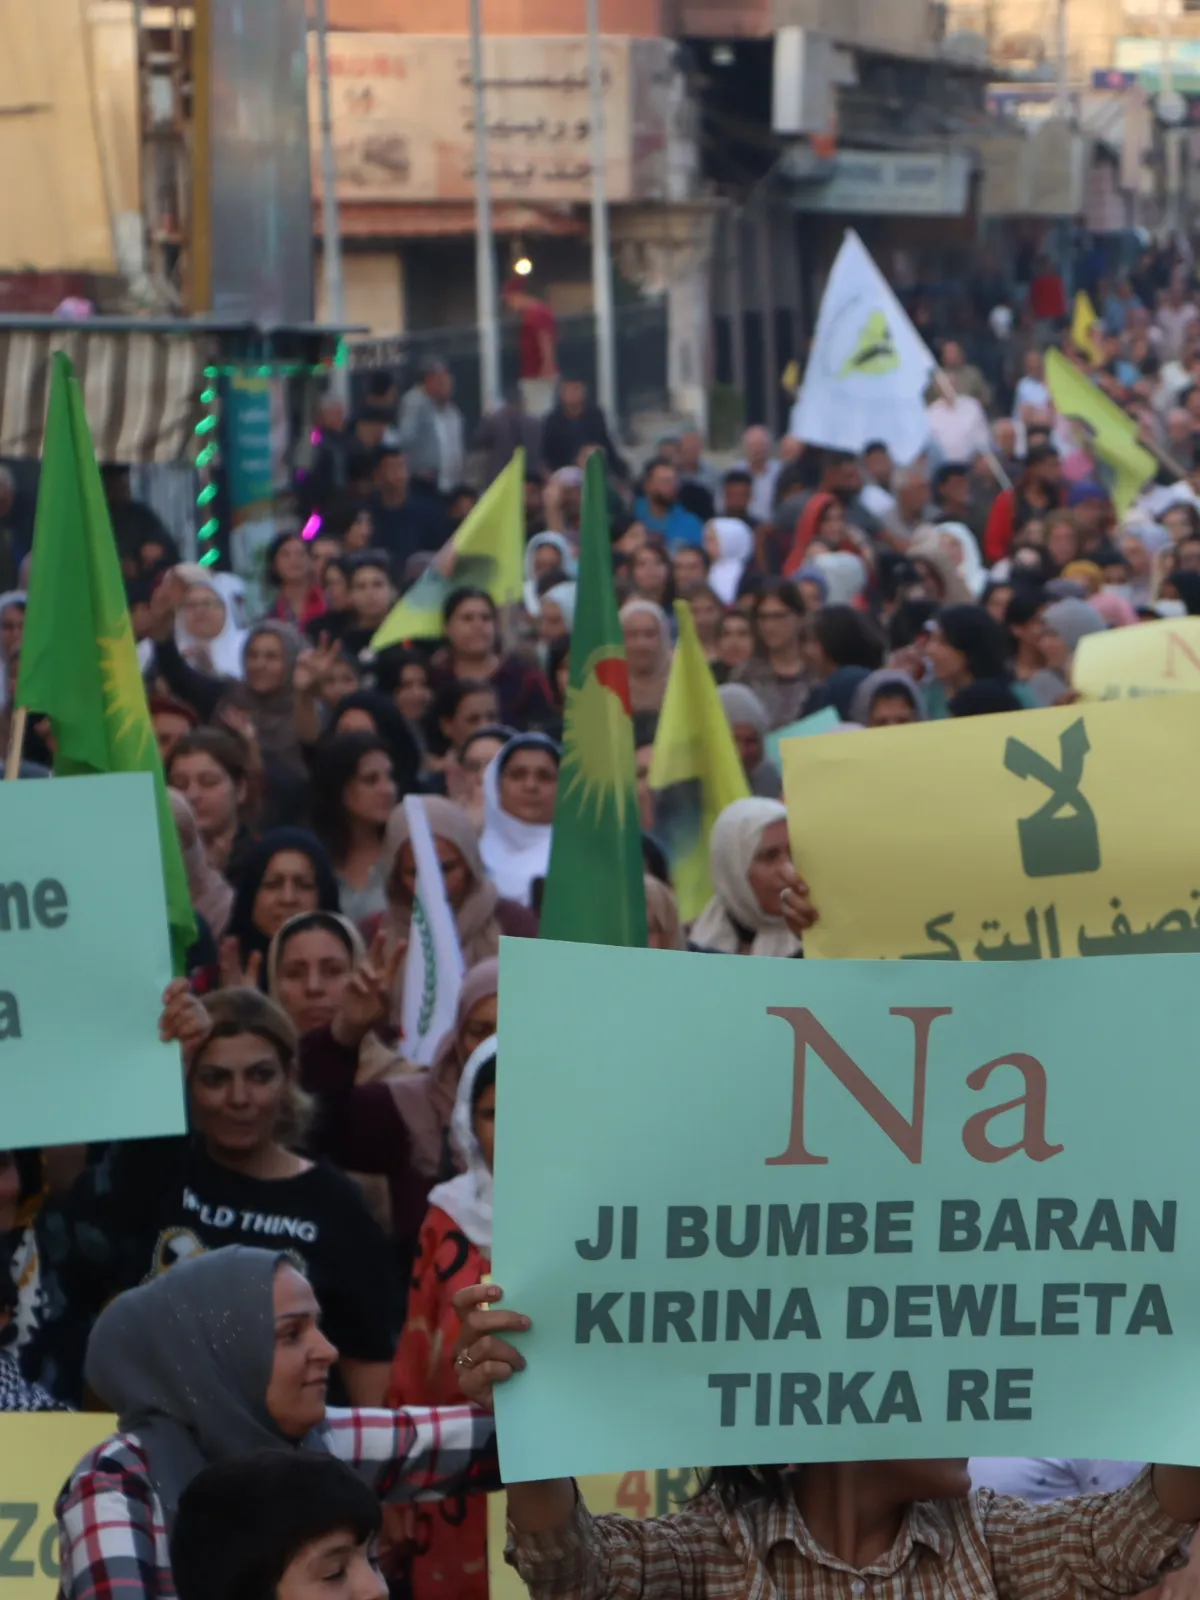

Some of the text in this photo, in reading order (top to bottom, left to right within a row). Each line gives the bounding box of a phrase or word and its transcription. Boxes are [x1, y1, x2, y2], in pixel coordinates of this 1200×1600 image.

[1004, 716, 1102, 879] لا
[765, 1006, 1064, 1166] Na
[240, 1211, 318, 1242] THING
[574, 1197, 1178, 1262] JI BUMBE BARAN
[573, 1281, 1174, 1345] KIRINA DEWLETA
[707, 1367, 1034, 1428] TIRKA RE
